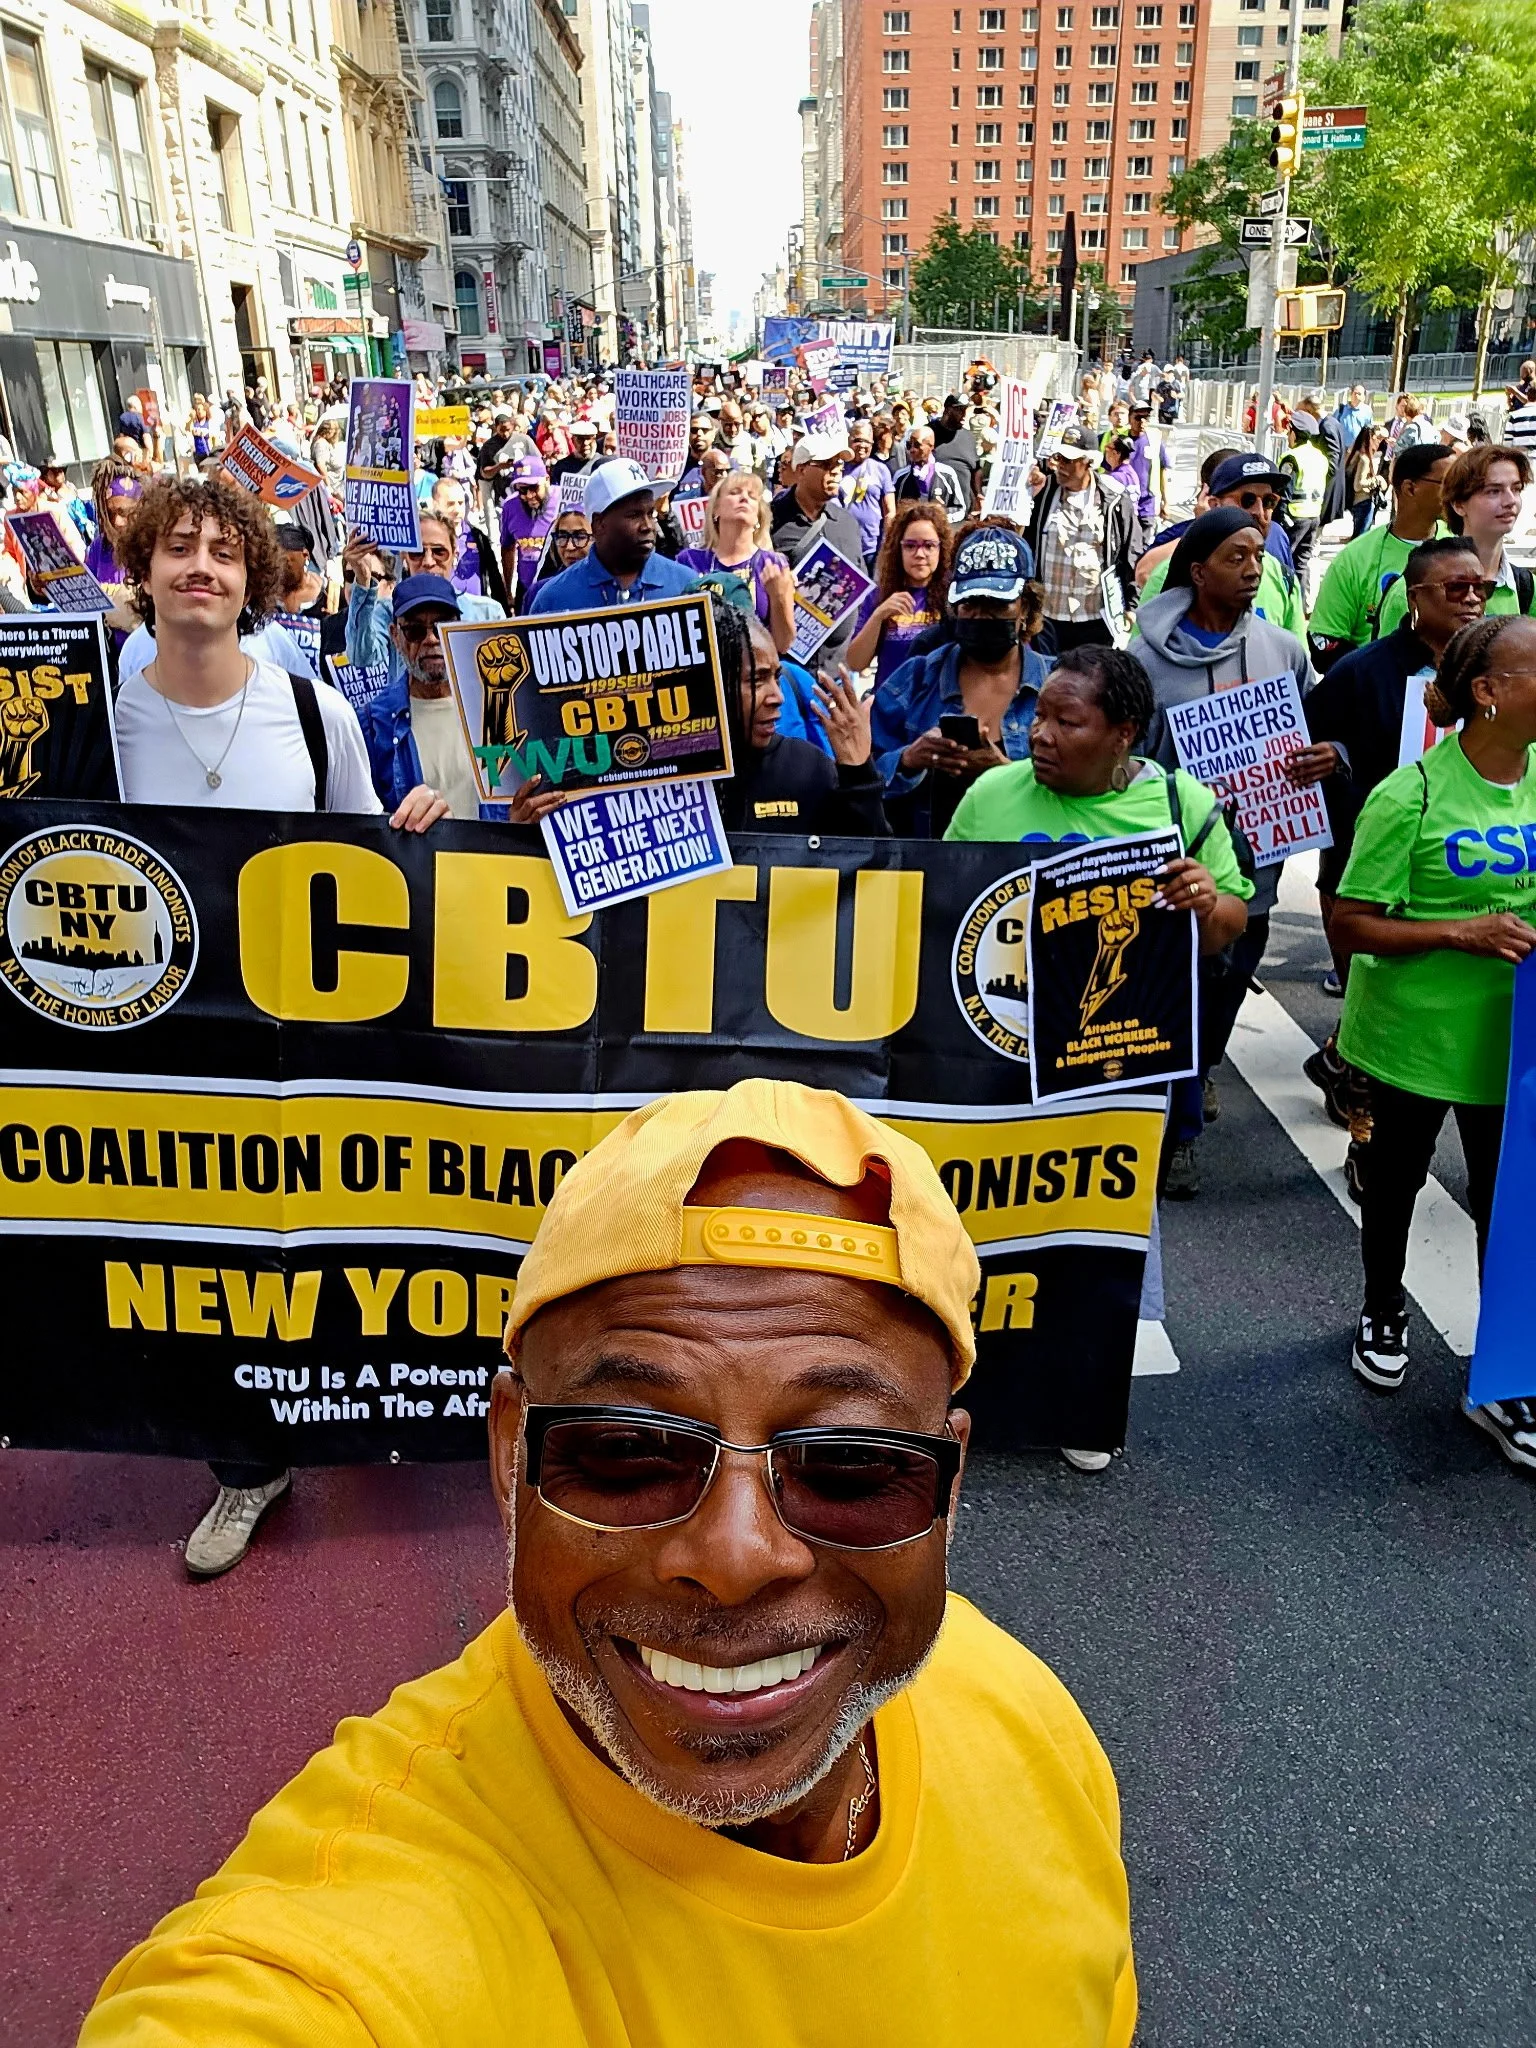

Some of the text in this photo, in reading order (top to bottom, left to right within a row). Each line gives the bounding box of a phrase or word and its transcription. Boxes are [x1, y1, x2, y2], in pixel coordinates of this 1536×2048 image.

[1303, 111, 1335, 127] uane St
[1302, 134, 1321, 144] onard
[1249, 226, 1268, 236] ONE
[818, 320, 892, 348] UNITY
[616, 373, 687, 389] HEALTHCARE
[617, 390, 686, 408] WORKERS
[1005, 383, 1029, 440] ICE
[617, 408, 687, 422] DEMAND JOBS
[618, 422, 686, 438] HOUSING
[620, 438, 684, 450] HEALTHCARE
[238, 435, 276, 474] FREEDOM
[1002, 439, 1019, 464] OUT
[360, 482, 409, 508] MARCH
[562, 475, 587, 489] HEALT
[357, 503, 376, 523] THE
[378, 506, 410, 526] NEXT
[991, 489, 1019, 512] YORK!
[357, 522, 412, 544] RATION!
[0, 627, 90, 642] here is a Threat
[528, 609, 706, 686] UNSTOPPABLE
[336, 666, 364, 683] WE
[343, 674, 388, 697] FOR THE
[584, 672, 653, 694] 1199SEIU
[560, 685, 690, 737] CBTU
[1172, 676, 1291, 733] HEALTHCARE
[648, 716, 717, 740] 1199SEIU
[1178, 702, 1297, 760] WORKERS
[1186, 731, 1304, 780] DEMAND JOBS
[1213, 755, 1296, 798] OUSIN
[553, 783, 702, 843] WE MARCH
[754, 801, 799, 815] CBTU
[1236, 791, 1320, 830] CATION
[564, 806, 706, 872] FOR THE NEXT
[1271, 811, 1327, 848] ALL!
[574, 833, 715, 901] GENERATION!
[1081, 850, 1130, 868] Anywhere
[18, 843, 37, 865] OF
[38, 833, 92, 856] BLACK
[94, 835, 148, 869] TRADE
[145, 862, 191, 943] UNIONISTS
[1066, 868, 1100, 886] Justice
[25, 880, 148, 912] CBTU
[1040, 876, 1160, 933] RESIS
[60, 911, 117, 940] NY
[958, 903, 998, 975] COALITION
[996, 885, 1016, 905] OF
[238, 841, 924, 1041] CBTU
[0, 957, 186, 1026] N.Y. THE HOME OF LABOR
[964, 994, 983, 1028] N.Y.
[986, 1023, 1022, 1053] THE
[1084, 1018, 1139, 1036] Attacks on
[1066, 1026, 1159, 1053] BLACK WORKERS
[1066, 1047, 1125, 1066] Indigenous
[1127, 1039, 1171, 1055] Peoples
[0, 1122, 1138, 1215] COALITION OF BLAC ONISTS
[104, 1259, 518, 1342] NEW YOR
[234, 1363, 310, 1393] CBTU
[321, 1366, 346, 1389] Is
[355, 1364, 380, 1388] A
[390, 1363, 488, 1387] Potent
[270, 1396, 370, 1425] Within
[379, 1394, 434, 1420] The
